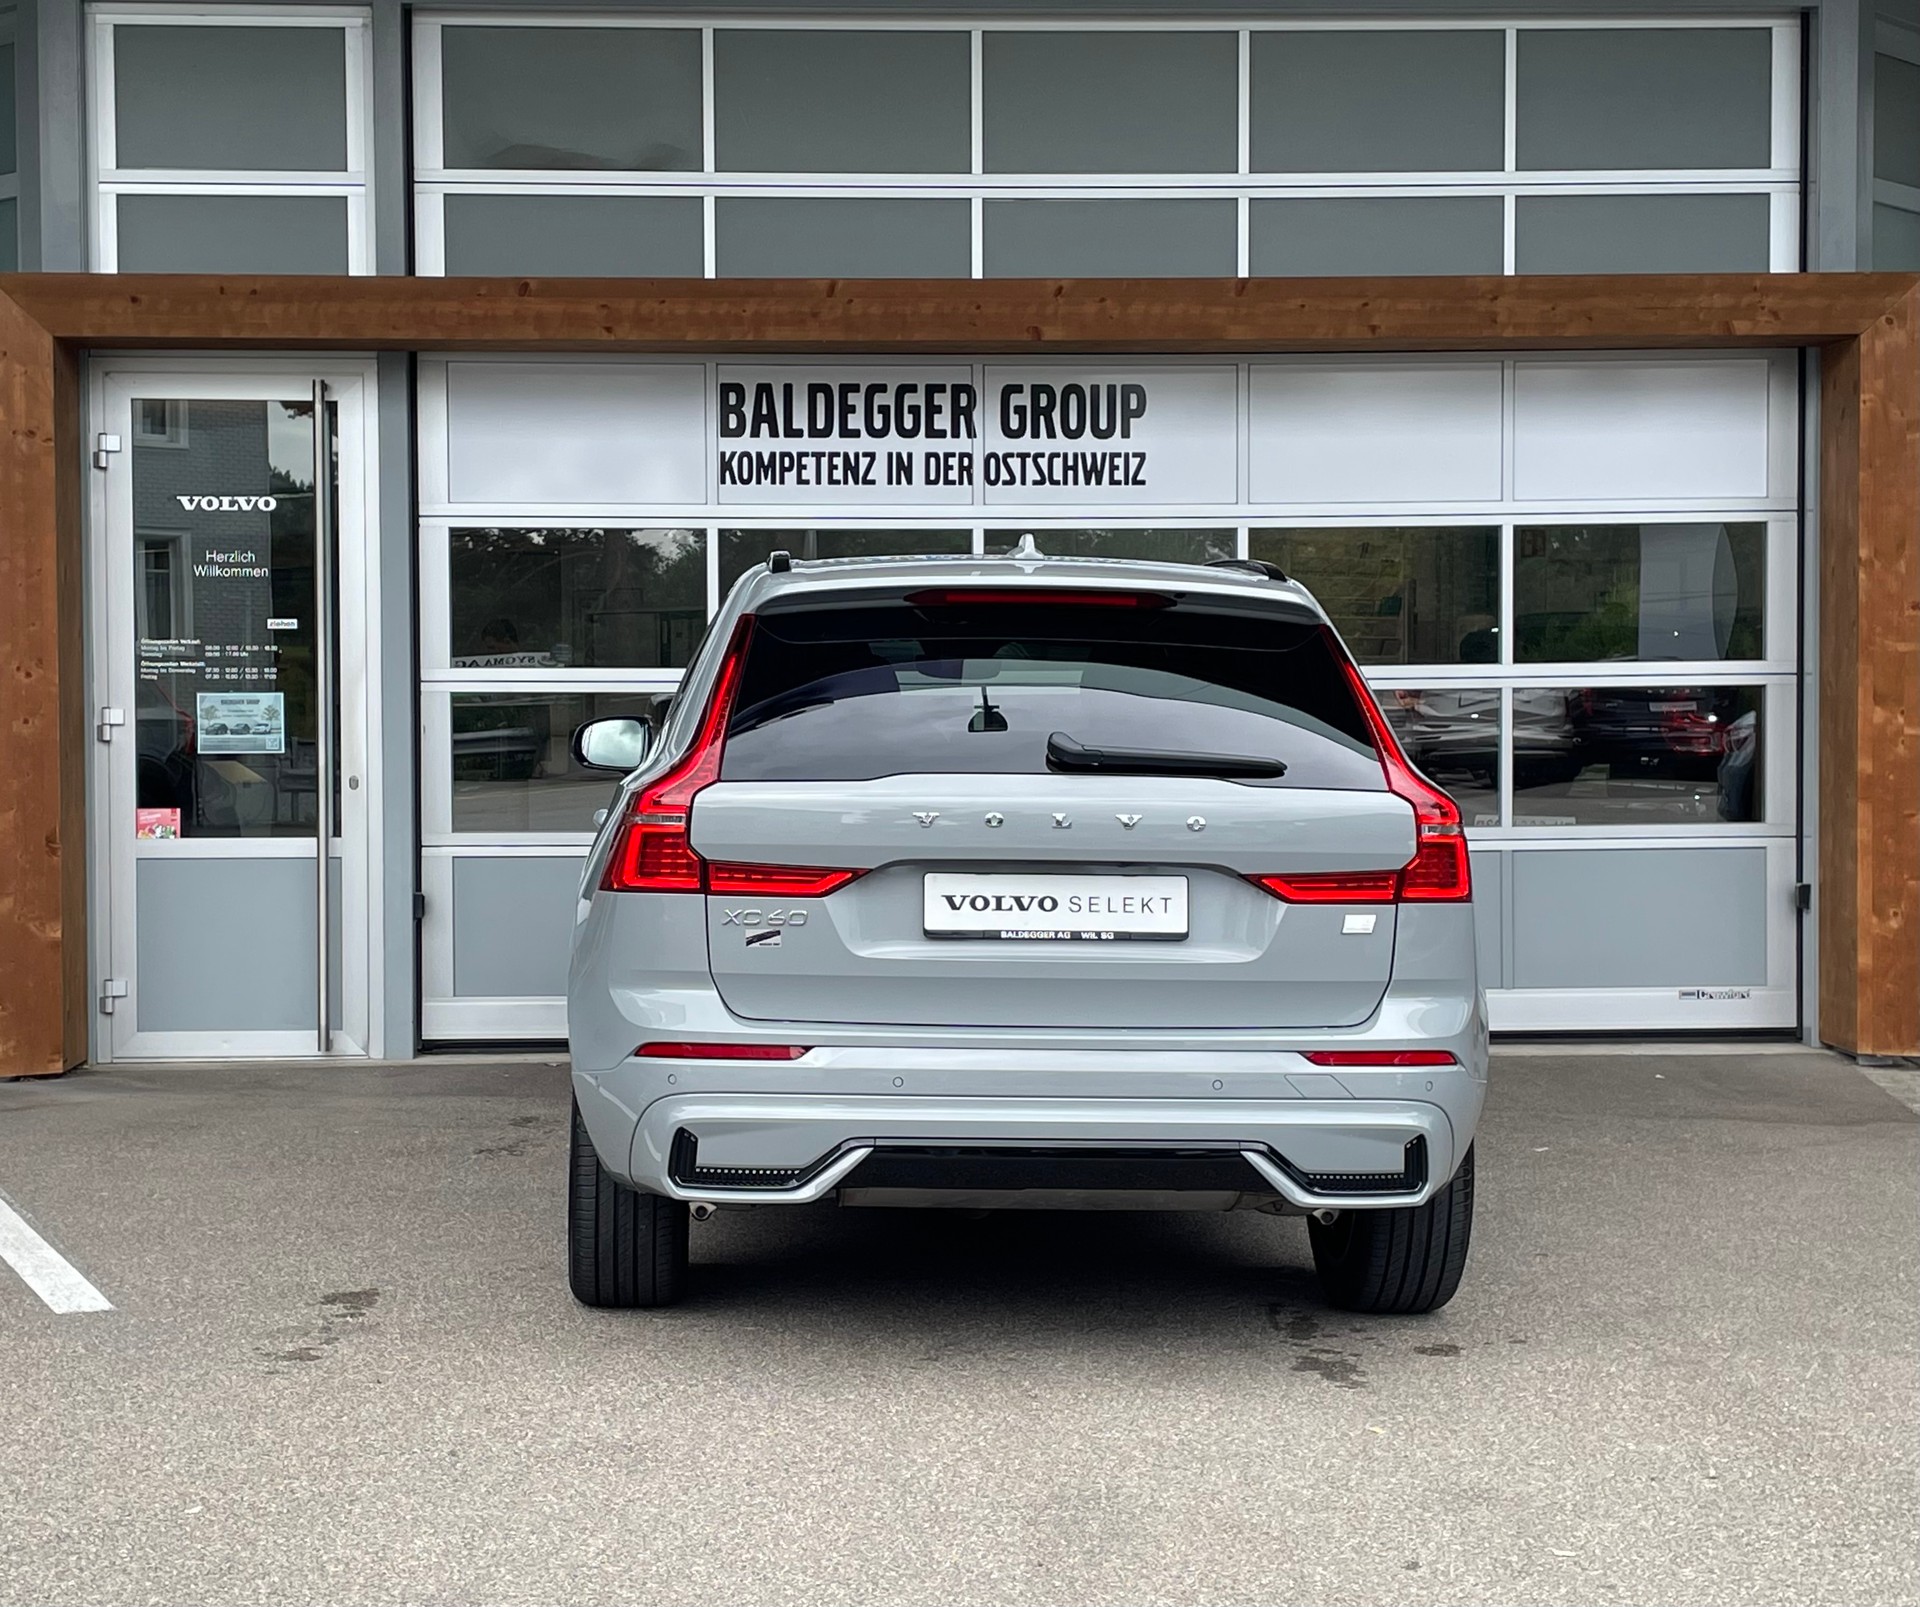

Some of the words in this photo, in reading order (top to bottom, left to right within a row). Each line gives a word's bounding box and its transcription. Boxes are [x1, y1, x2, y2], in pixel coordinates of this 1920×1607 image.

[719, 382, 977, 439] BALDEGGER
[1000, 383, 1147, 440] GROUP
[720, 450, 876, 486] KOMPETENZ
[887, 451, 913, 486] IN
[924, 451, 973, 486] DER
[983, 451, 1147, 487] OSTSCHWEIZ
[177, 495, 277, 512] VOLVO
[206, 550, 256, 563] Herzlich
[193, 565, 269, 578] Willkommen
[912, 811, 1207, 832] VOLVO
[941, 894, 1059, 912] VOLVO
[1068, 895, 1173, 914] SELEKT
[722, 908, 808, 926] XC60
[1000, 930, 1055, 939] BALDEGGER
[1057, 931, 1071, 939] AG
[1101, 932, 1115, 940] SG
